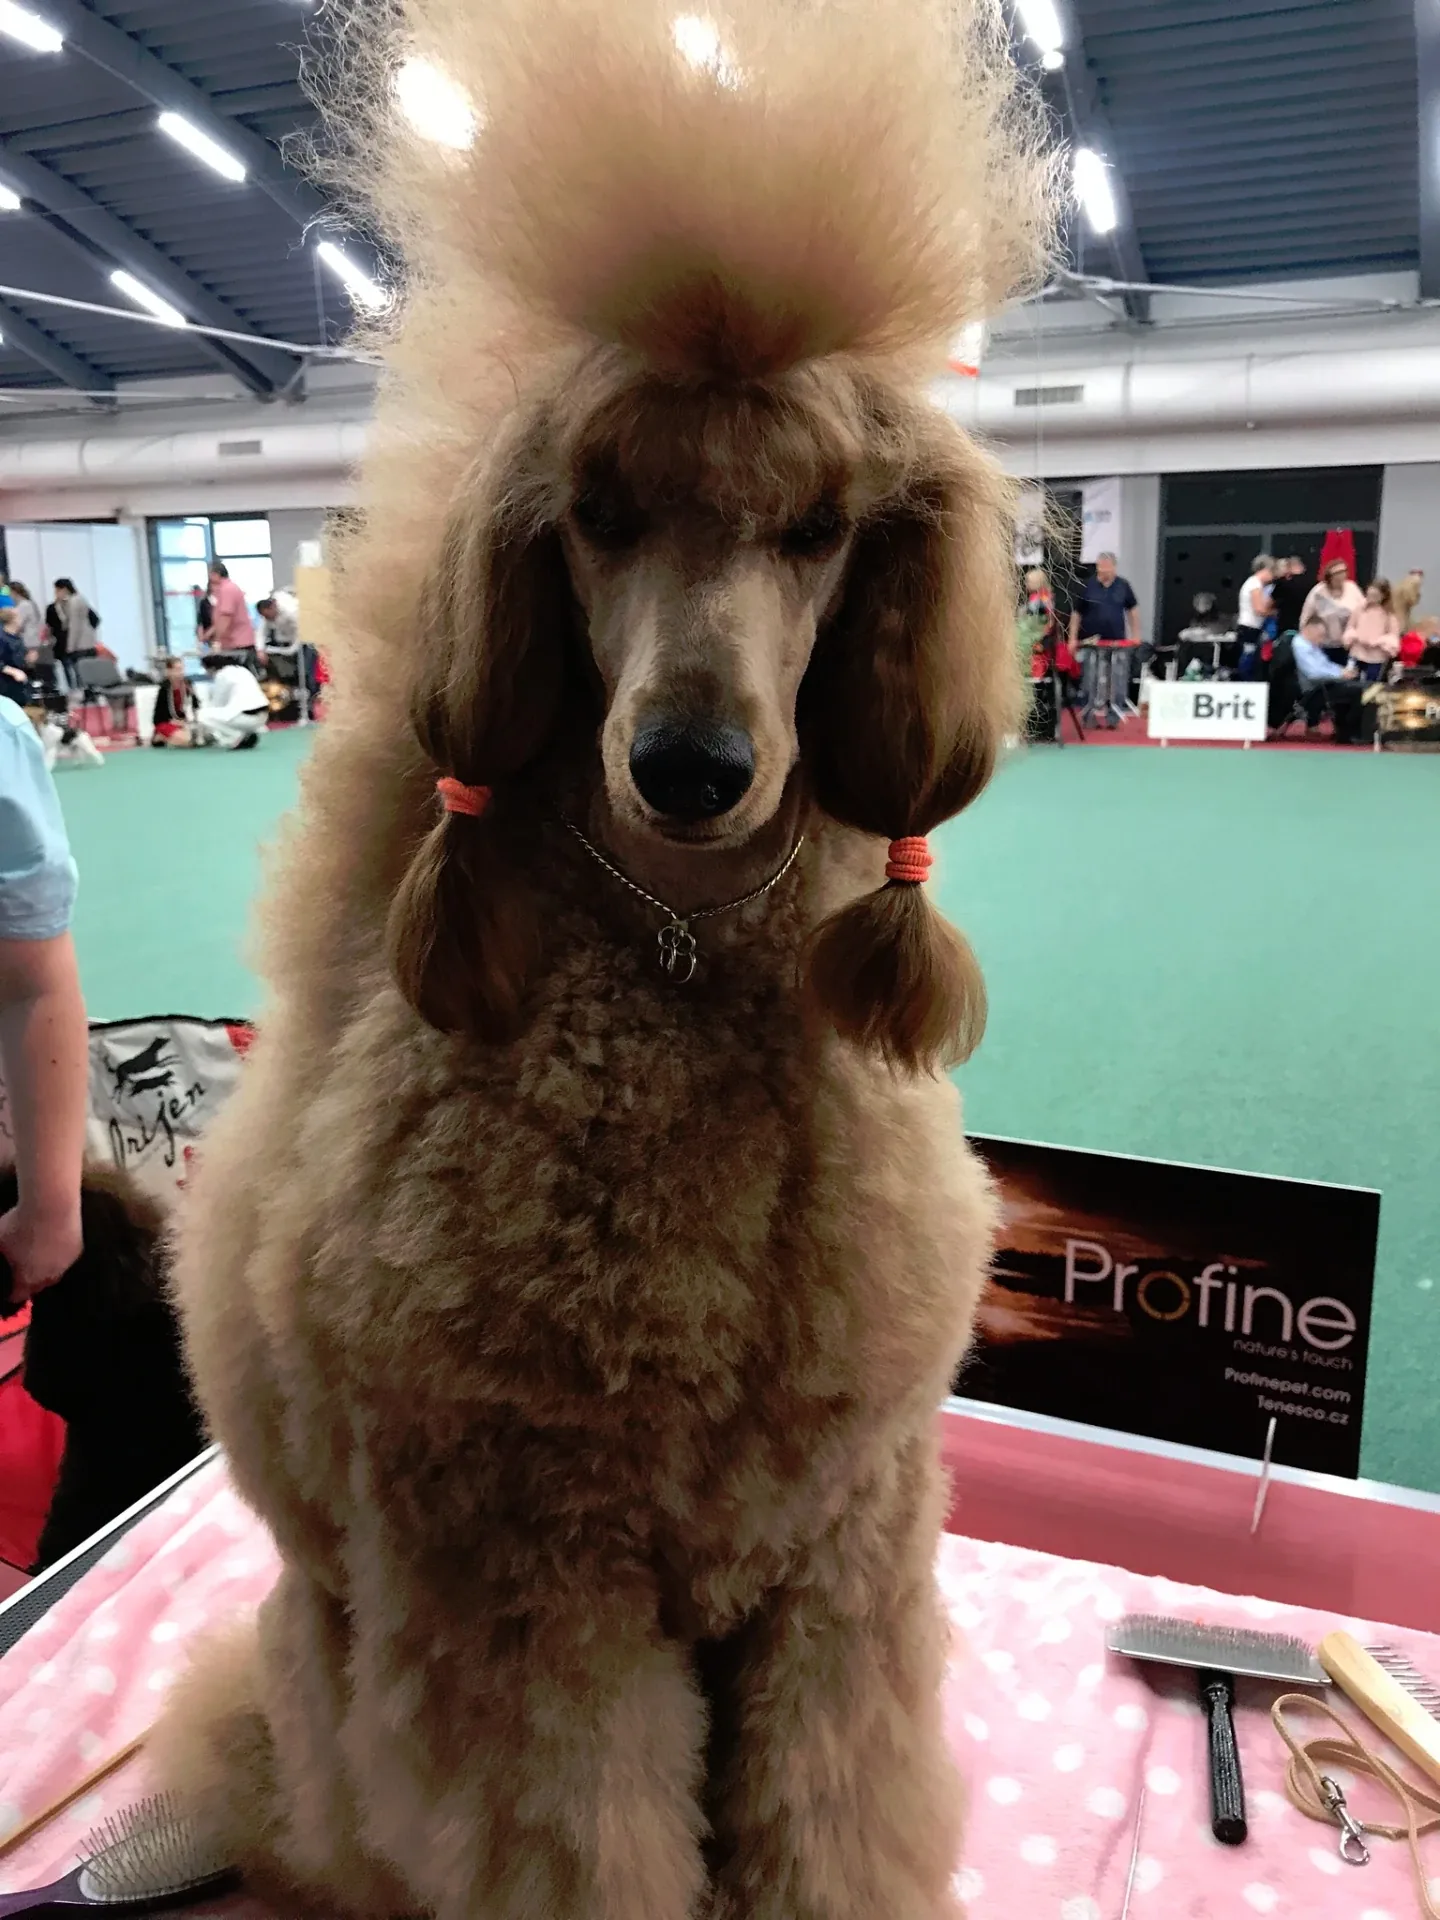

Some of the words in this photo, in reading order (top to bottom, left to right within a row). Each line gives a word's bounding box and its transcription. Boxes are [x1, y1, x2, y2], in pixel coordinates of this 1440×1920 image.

[1193, 693, 1256, 720] Brit
[1064, 1239, 1356, 1350] Profine
[1303, 1349, 1353, 1370] touch
[1224, 1367, 1351, 1403] Profinepet.com
